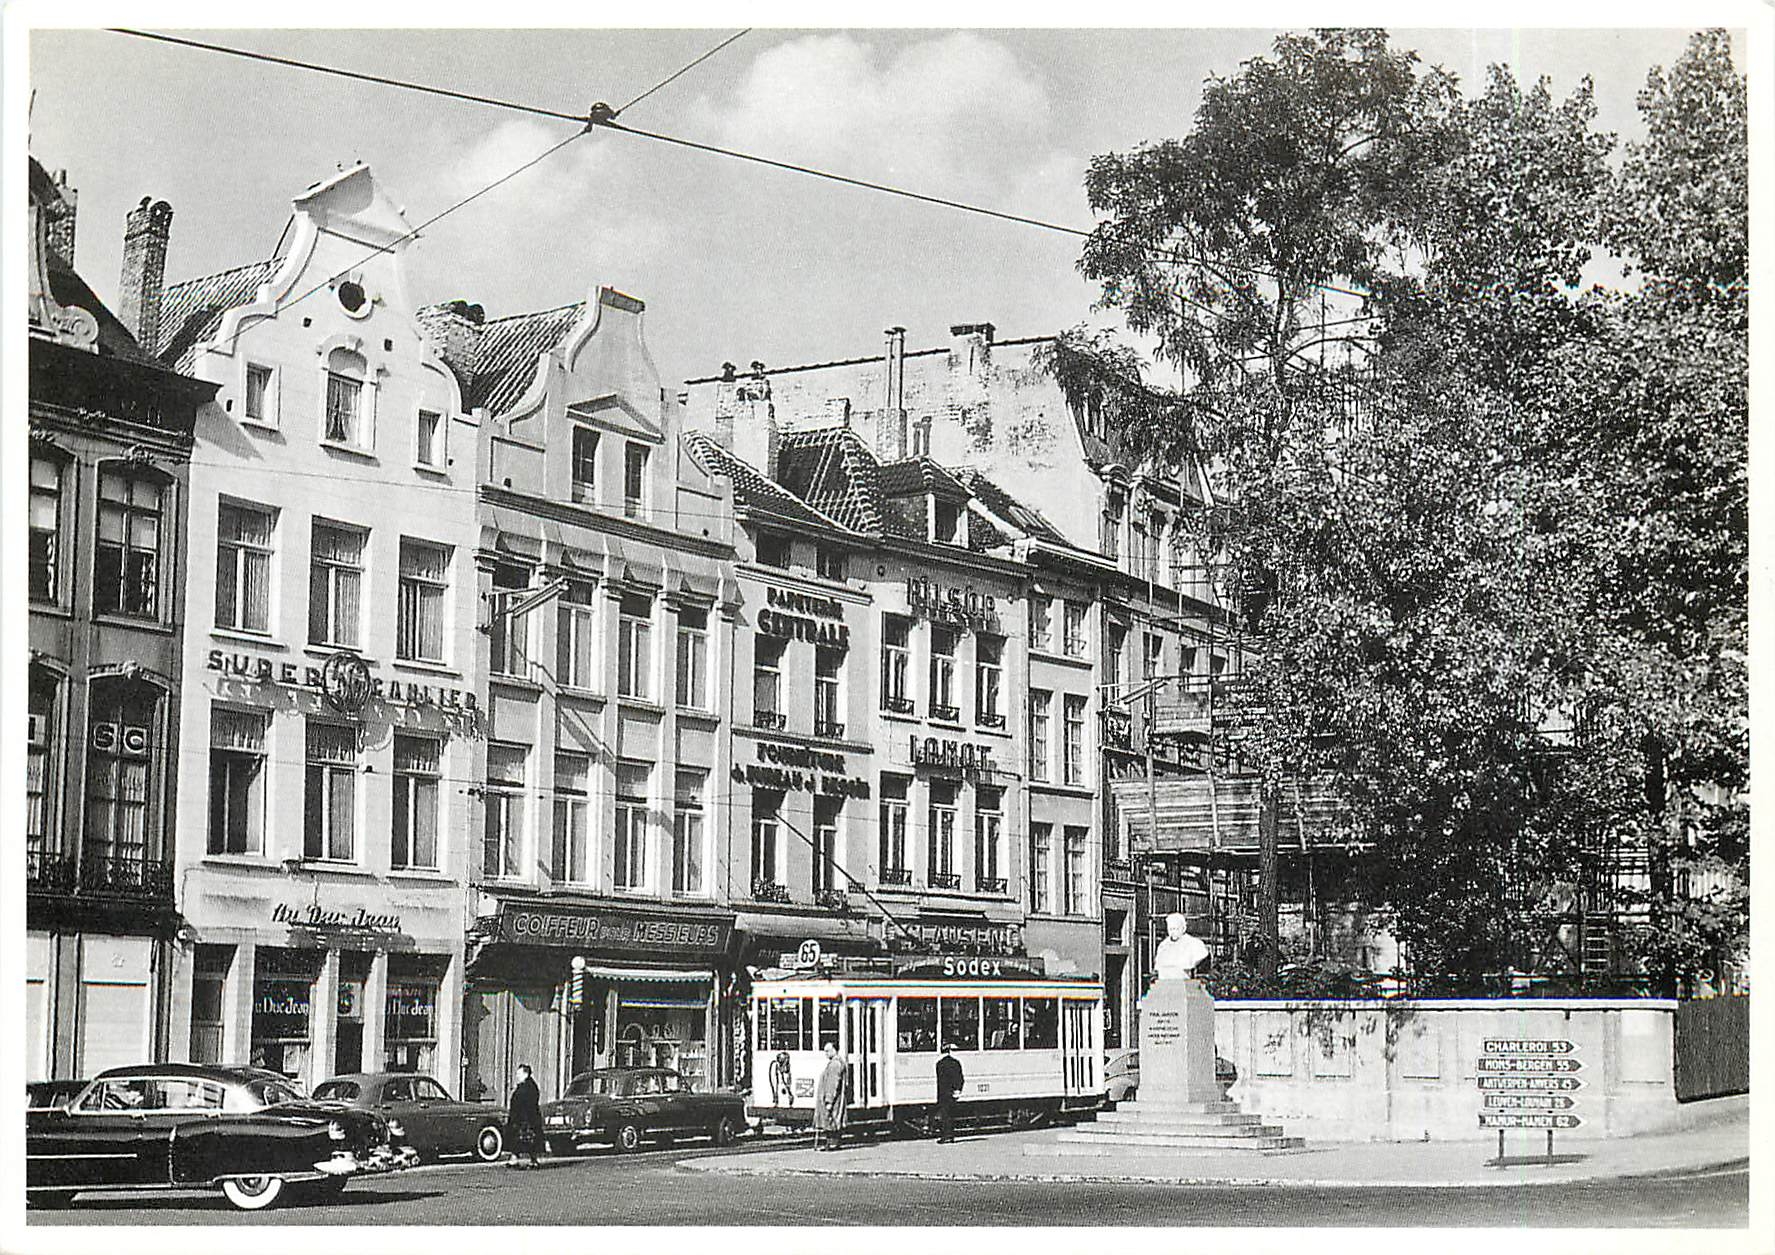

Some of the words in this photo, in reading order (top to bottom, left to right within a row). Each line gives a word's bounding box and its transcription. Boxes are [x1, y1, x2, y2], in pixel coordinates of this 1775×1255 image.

[757, 608, 850, 647] CENTRALE
[909, 734, 993, 770] LAMOT
[513, 912, 599, 939] COIFFEUR
[632, 921, 718, 946] MESSIEURS
[801, 943, 816, 963] 65
[943, 956, 1001, 976] Sodex
[1486, 1042, 1548, 1052] CHARLEROI
[1485, 1060, 1552, 1071] MONS-BERGEN
